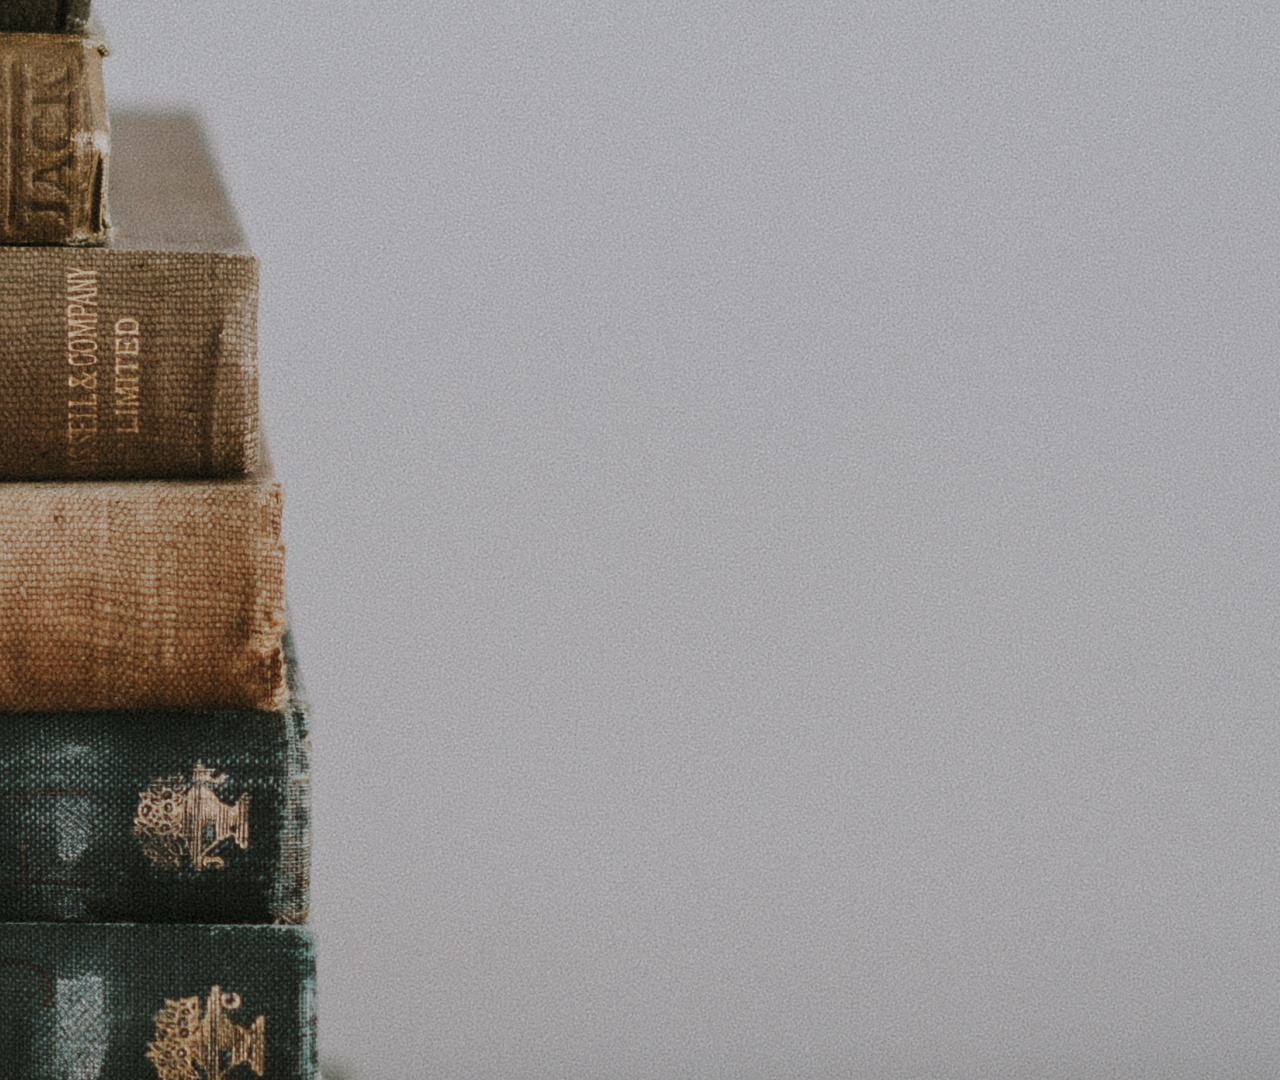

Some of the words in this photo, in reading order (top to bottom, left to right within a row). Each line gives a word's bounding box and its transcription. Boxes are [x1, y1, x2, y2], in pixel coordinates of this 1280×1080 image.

[27, 65, 71, 221] JACK
[67, 267, 98, 366] COMPANY
[68, 371, 98, 389] &
[115, 317, 139, 434] LIMITED
